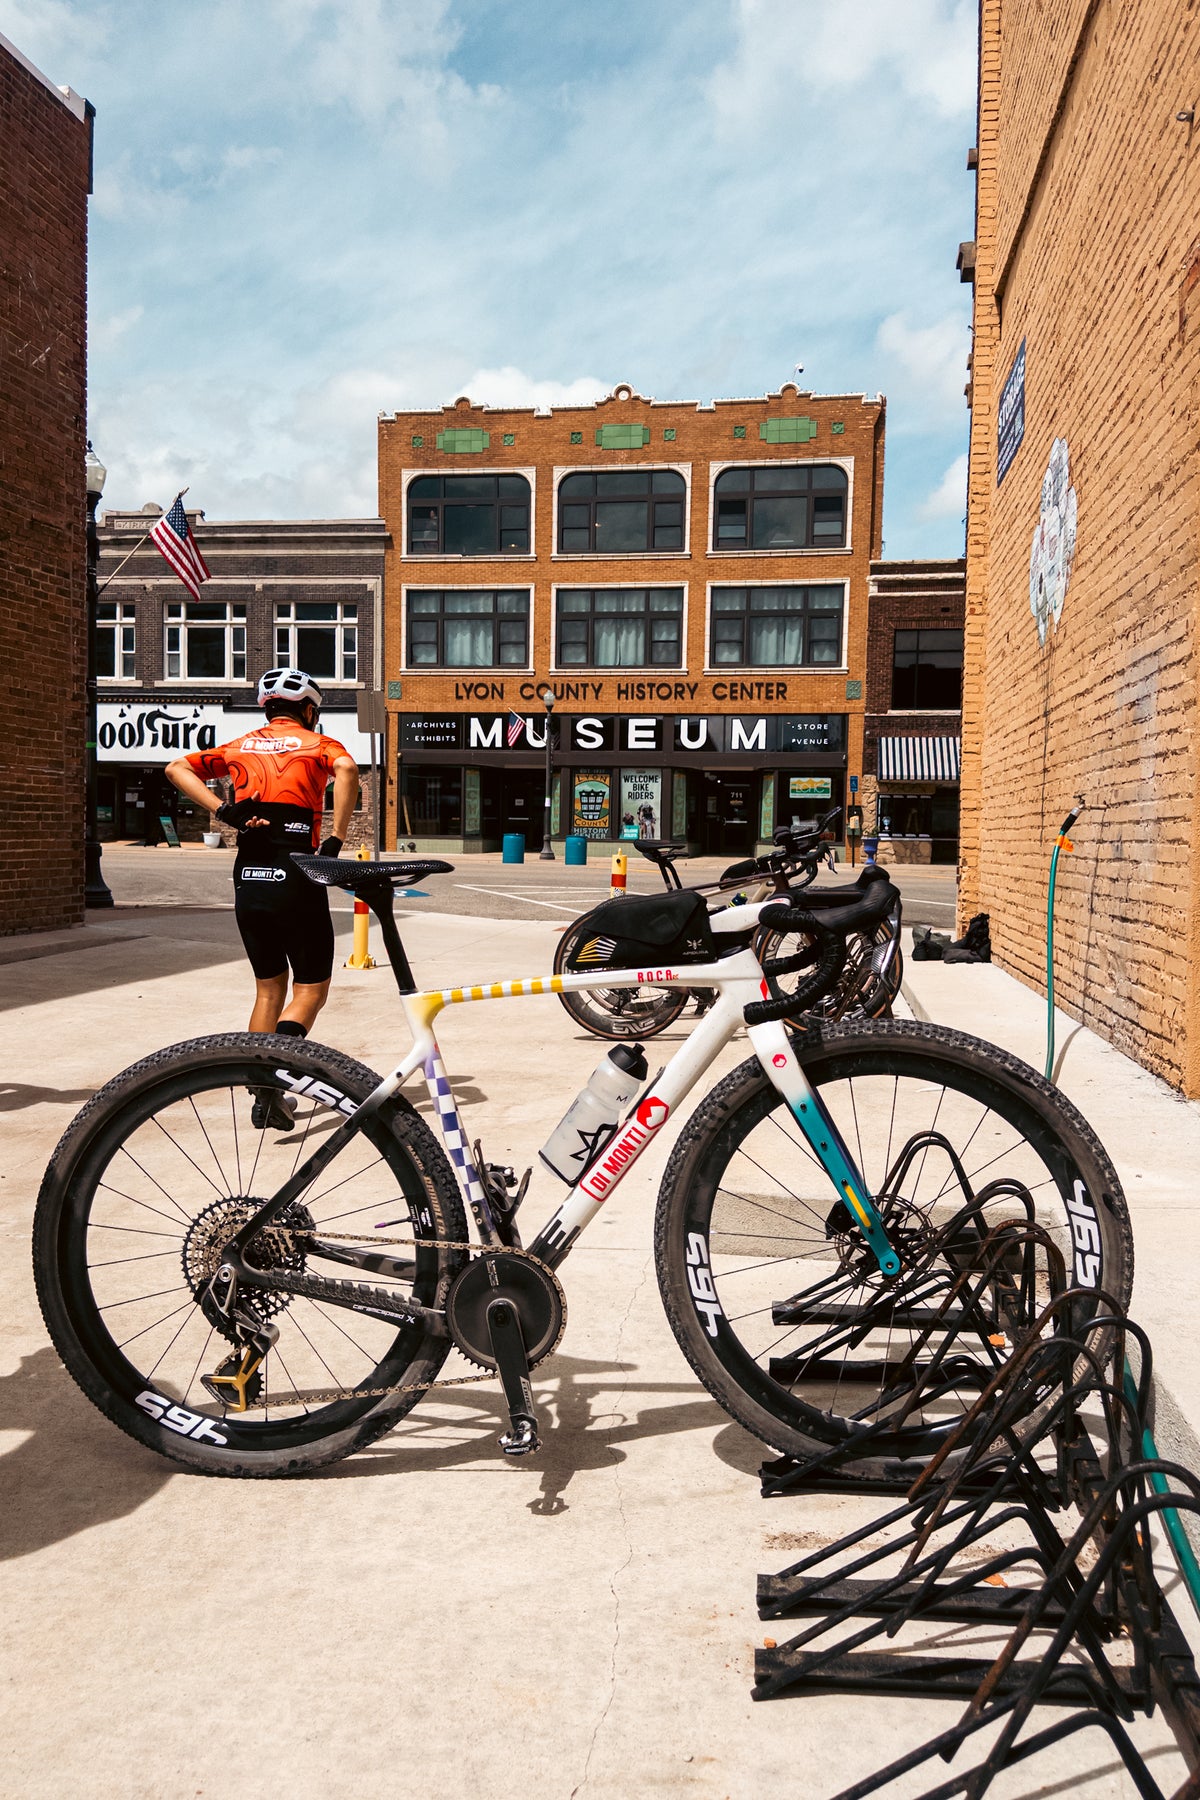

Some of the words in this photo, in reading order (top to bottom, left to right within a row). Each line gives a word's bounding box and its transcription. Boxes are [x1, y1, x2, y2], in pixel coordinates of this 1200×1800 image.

[455, 682, 505, 700] LYON
[519, 682, 603, 700] COUNTY
[617, 682, 699, 700] HISTORY
[711, 682, 788, 700] CENTER
[797, 723, 829, 731] STORE
[469, 717, 767, 750] MUSEUM
[576, 774, 608, 783] LYON
[623, 774, 659, 783] WELCOME
[632, 783, 649, 791] BIKE
[627, 791, 655, 800] RIDERS
[730, 791, 743, 799] 711
[574, 818, 608, 827] COUNTY
[637, 969, 673, 983] ROCA
[589, 1171, 612, 1193] DI
[602, 1126, 648, 1176] MONTI
